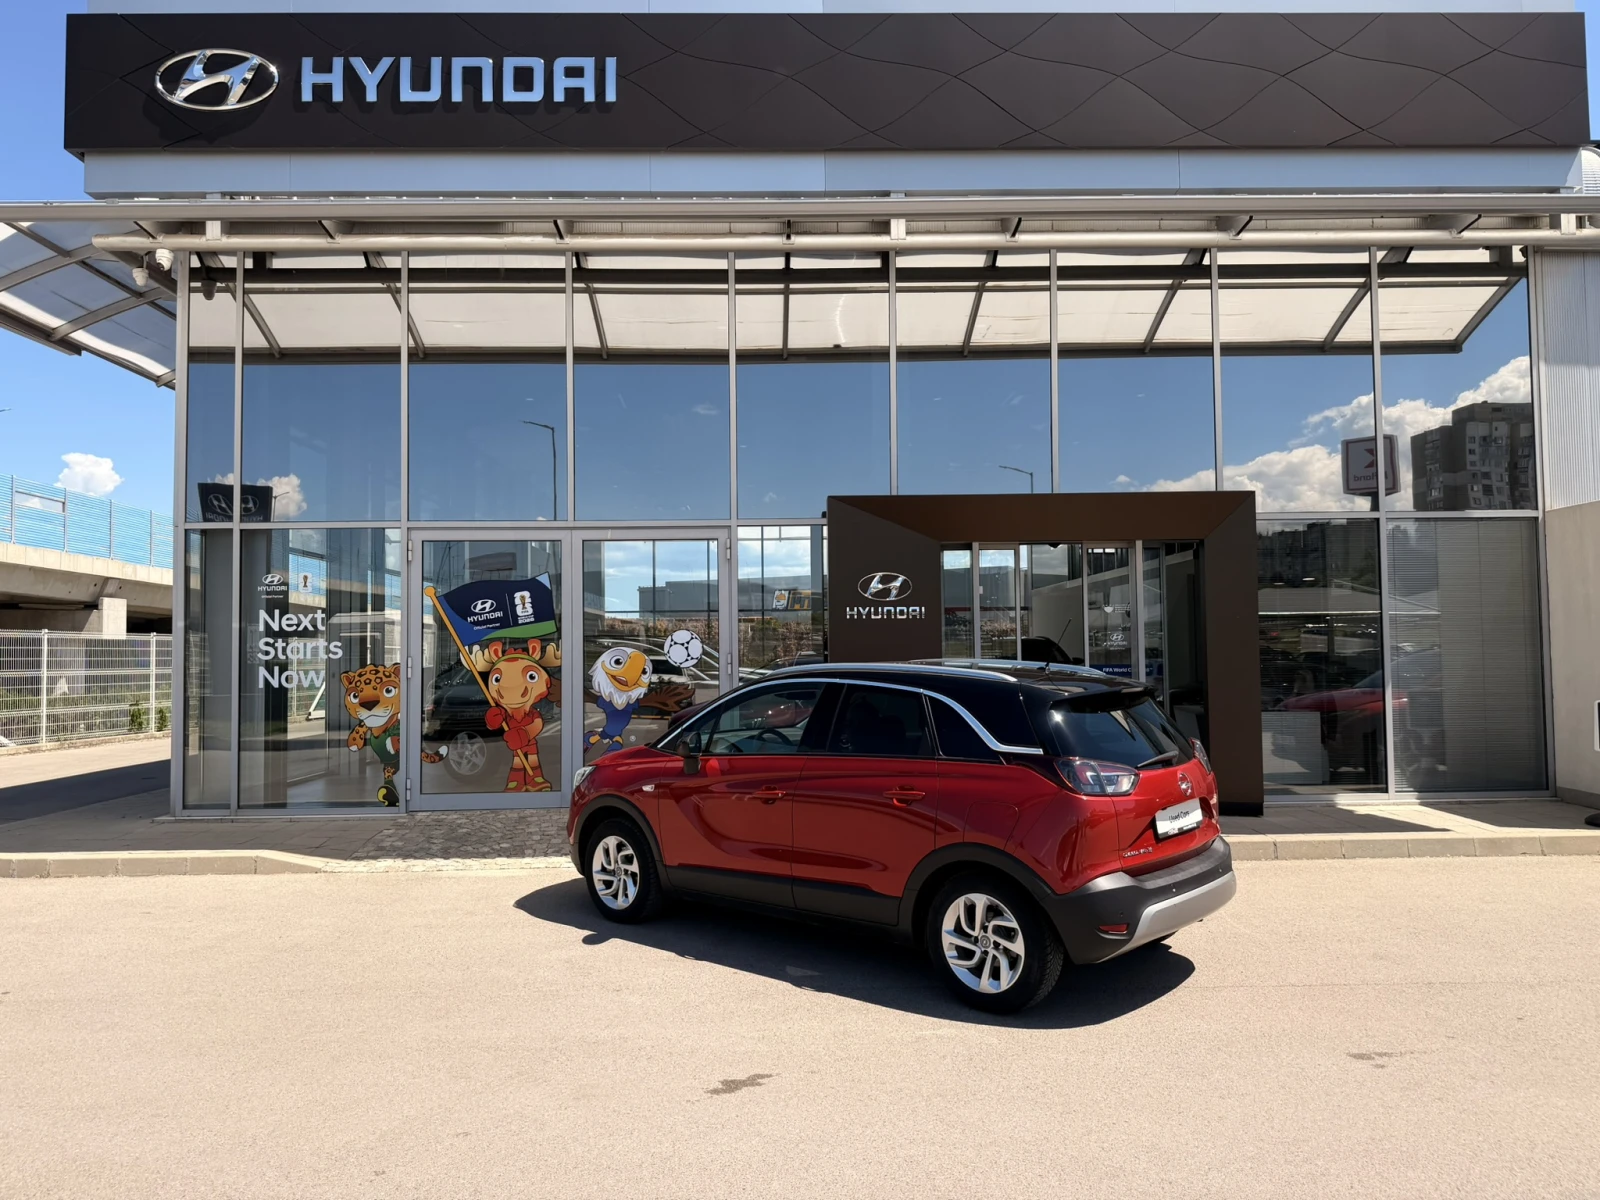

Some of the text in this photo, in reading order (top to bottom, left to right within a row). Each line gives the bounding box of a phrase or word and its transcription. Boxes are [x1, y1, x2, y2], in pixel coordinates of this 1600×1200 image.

[301, 56, 617, 103] HYUNDAI
[258, 609, 326, 632] Next
[467, 611, 503, 622] HYUNDAI
[846, 606, 926, 619] HYUNDAI
[257, 637, 343, 660] Starts
[258, 666, 326, 689] Now
